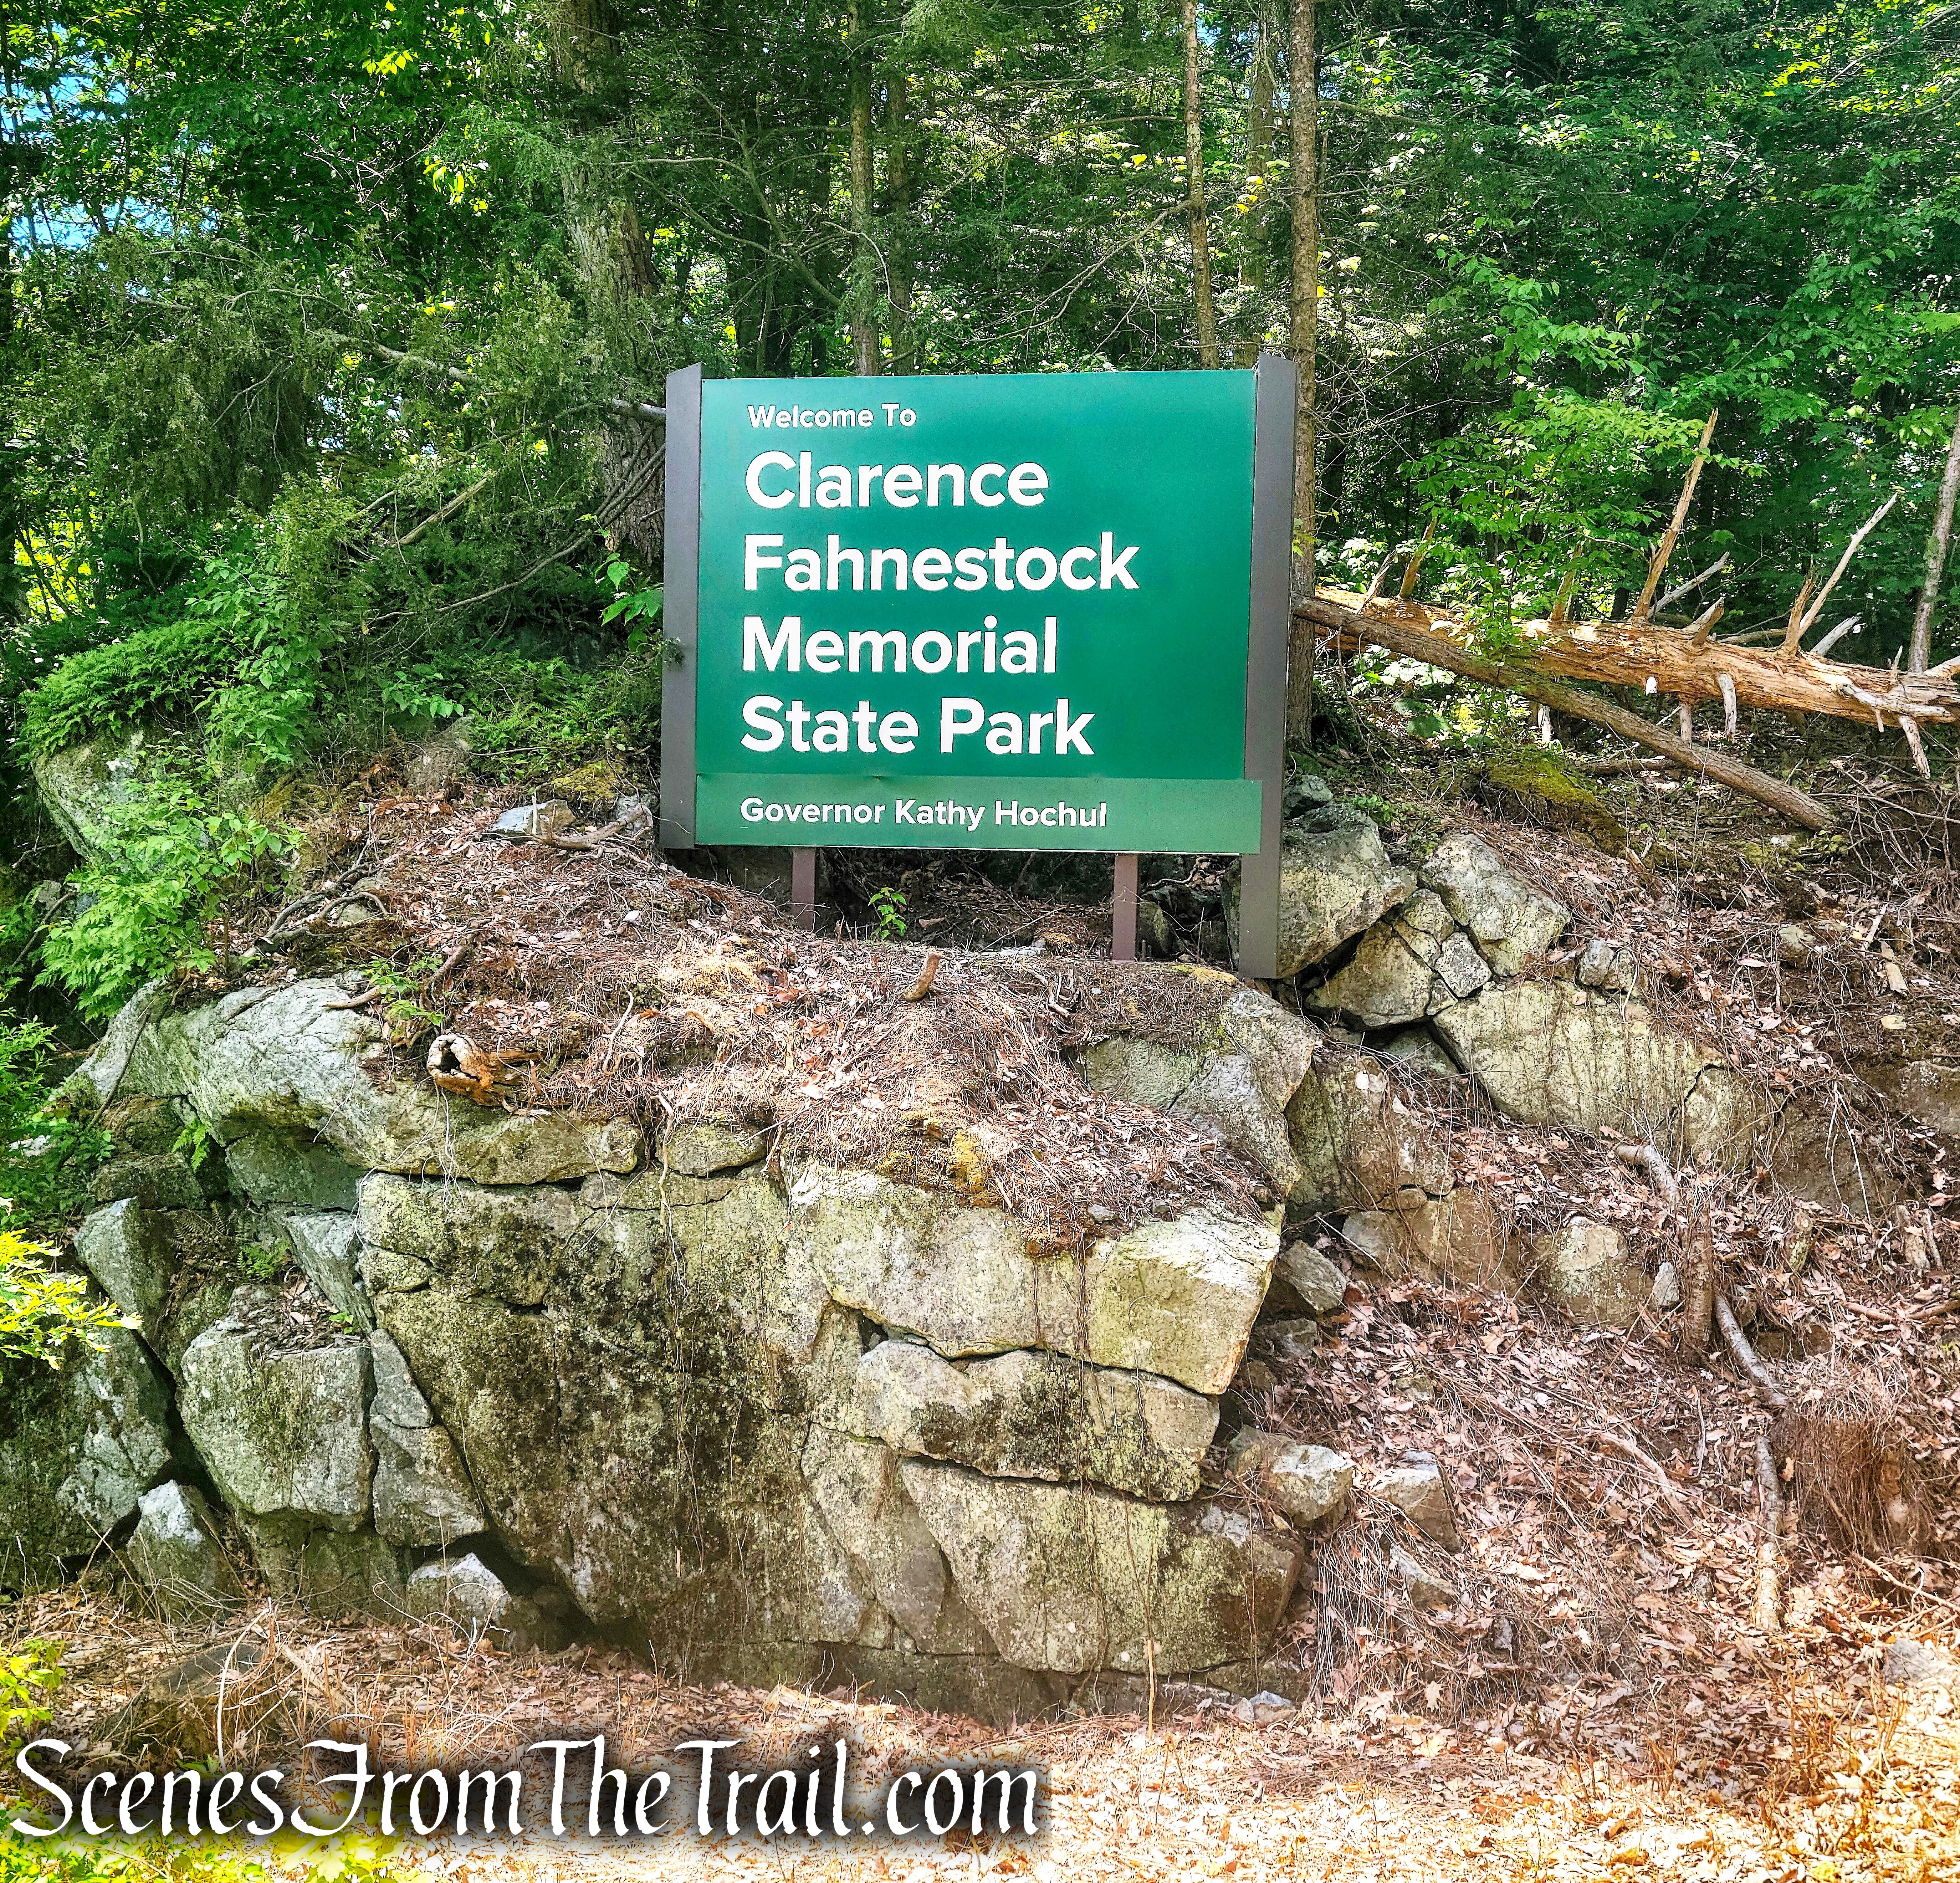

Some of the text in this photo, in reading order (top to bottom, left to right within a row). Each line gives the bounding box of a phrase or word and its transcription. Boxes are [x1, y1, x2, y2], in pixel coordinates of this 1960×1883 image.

[747, 403, 917, 429] Welcome To
[745, 451, 1049, 509] Clarence
[744, 532, 1141, 592] Fahnestock
[742, 615, 1058, 674] Memorial
[740, 695, 1096, 756] State Park
[740, 797, 1107, 832] Governor Kathy Hochul
